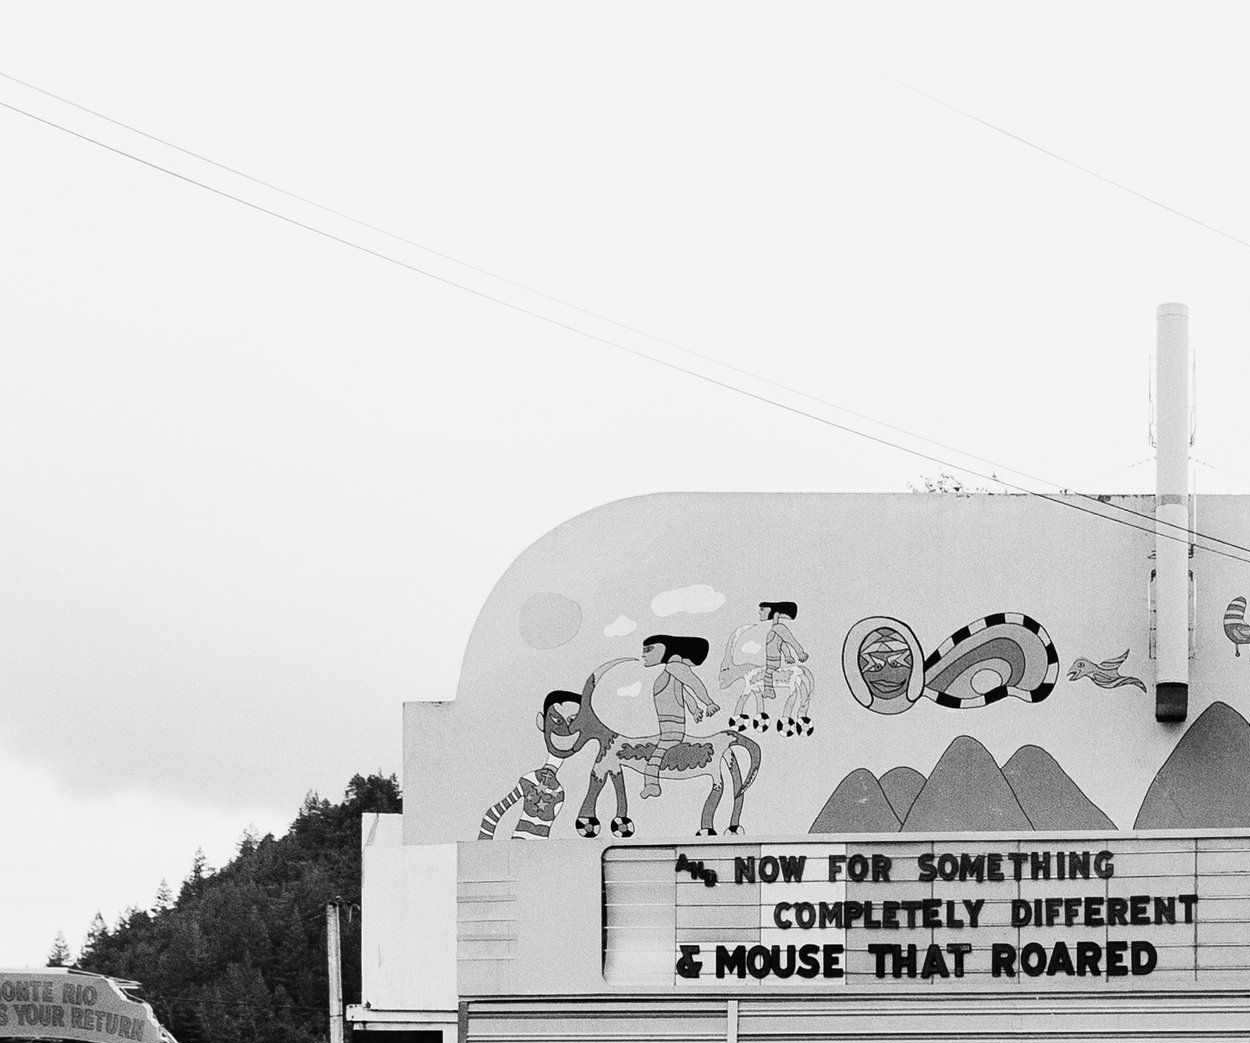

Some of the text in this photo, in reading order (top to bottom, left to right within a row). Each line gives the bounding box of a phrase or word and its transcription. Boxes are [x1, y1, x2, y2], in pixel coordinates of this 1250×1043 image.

[675, 851, 1115, 887] AND NOW FOR SOMETHING
[774, 894, 1200, 930] COMPLETELY DIFFERENT
[676, 941, 1158, 979] & MOUSE THAT ROARED
[0, 980, 98, 1006] ONTE RIO
[13, 1003, 65, 1027] YOUR
[71, 1007, 146, 1042] RETURN
